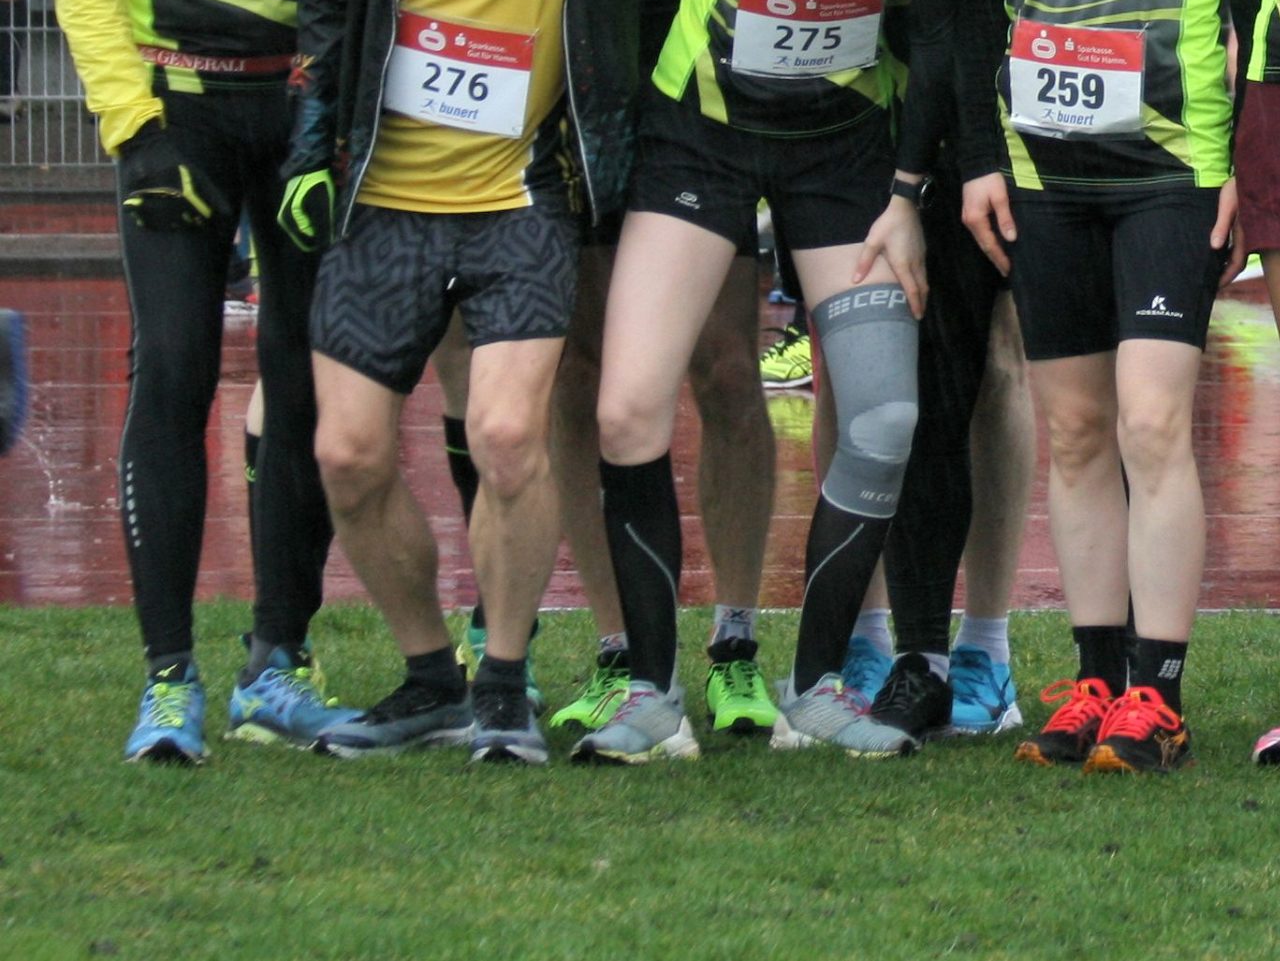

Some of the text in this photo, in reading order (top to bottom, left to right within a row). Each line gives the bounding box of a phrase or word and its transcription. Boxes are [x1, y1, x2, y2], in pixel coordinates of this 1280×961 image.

[773, 25, 842, 51] 275
[157, 50, 246, 72] GENERALI
[794, 55, 834, 67] bunert
[421, 62, 489, 102] 276
[1037, 67, 1105, 109] 259
[439, 102, 480, 119] bunert
[1057, 110, 1095, 125] bunert
[853, 289, 907, 309] cep
